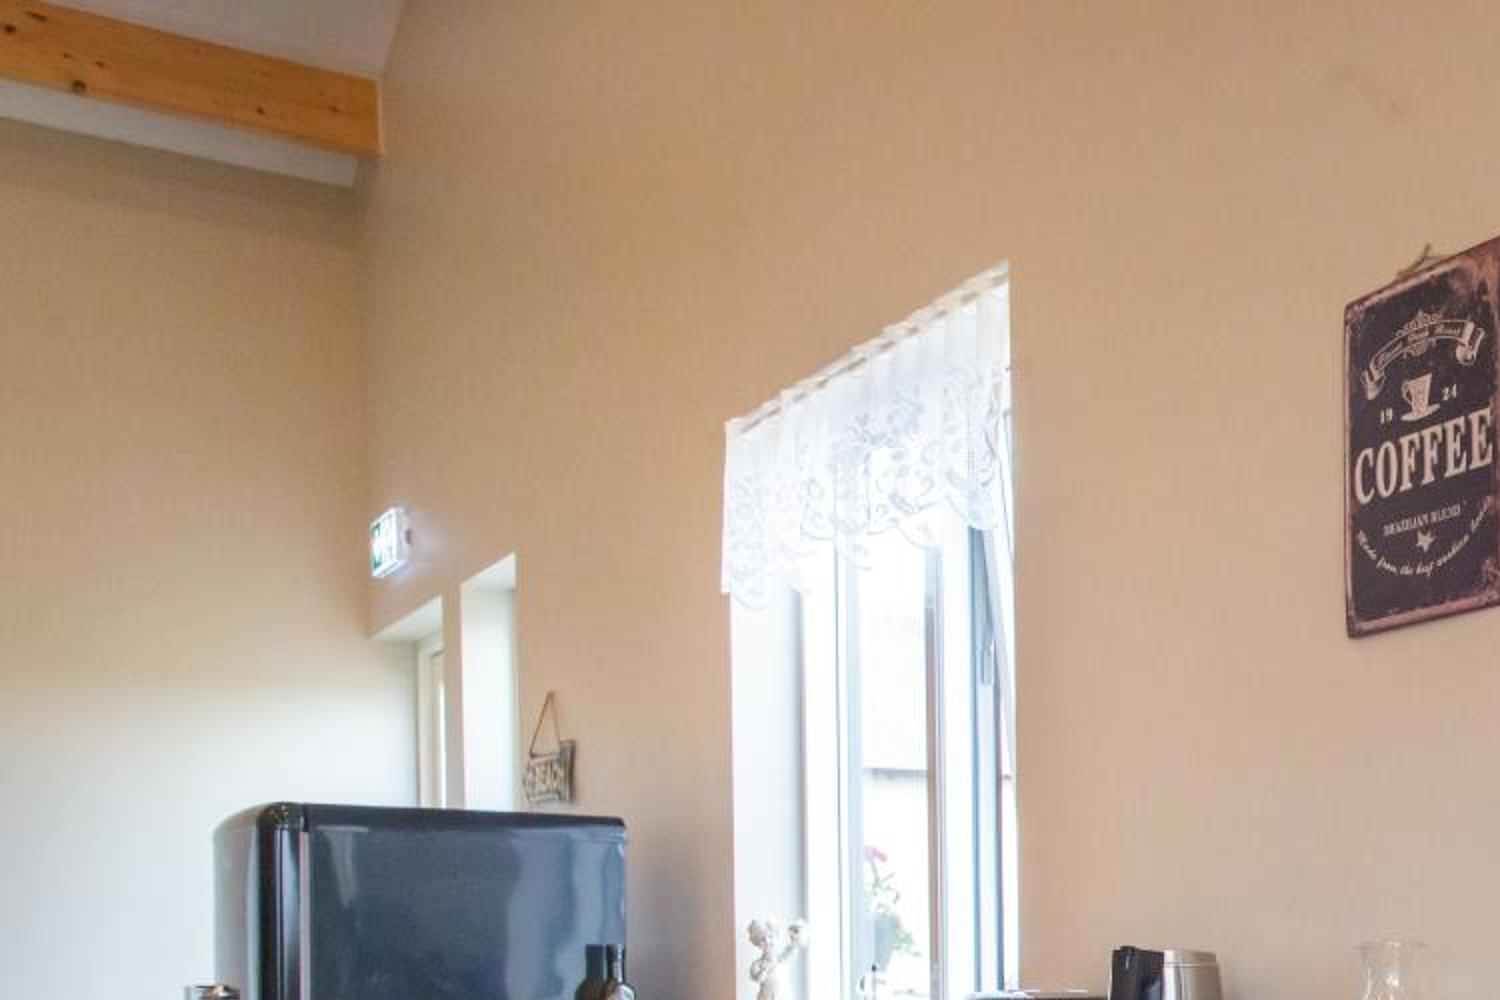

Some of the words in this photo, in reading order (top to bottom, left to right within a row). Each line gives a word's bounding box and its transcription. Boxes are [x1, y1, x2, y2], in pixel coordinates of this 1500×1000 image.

[1355, 406, 1493, 505] COFFEE
[1383, 513, 1430, 537] BRAZILIAN
[1429, 504, 1461, 523] BLEND
